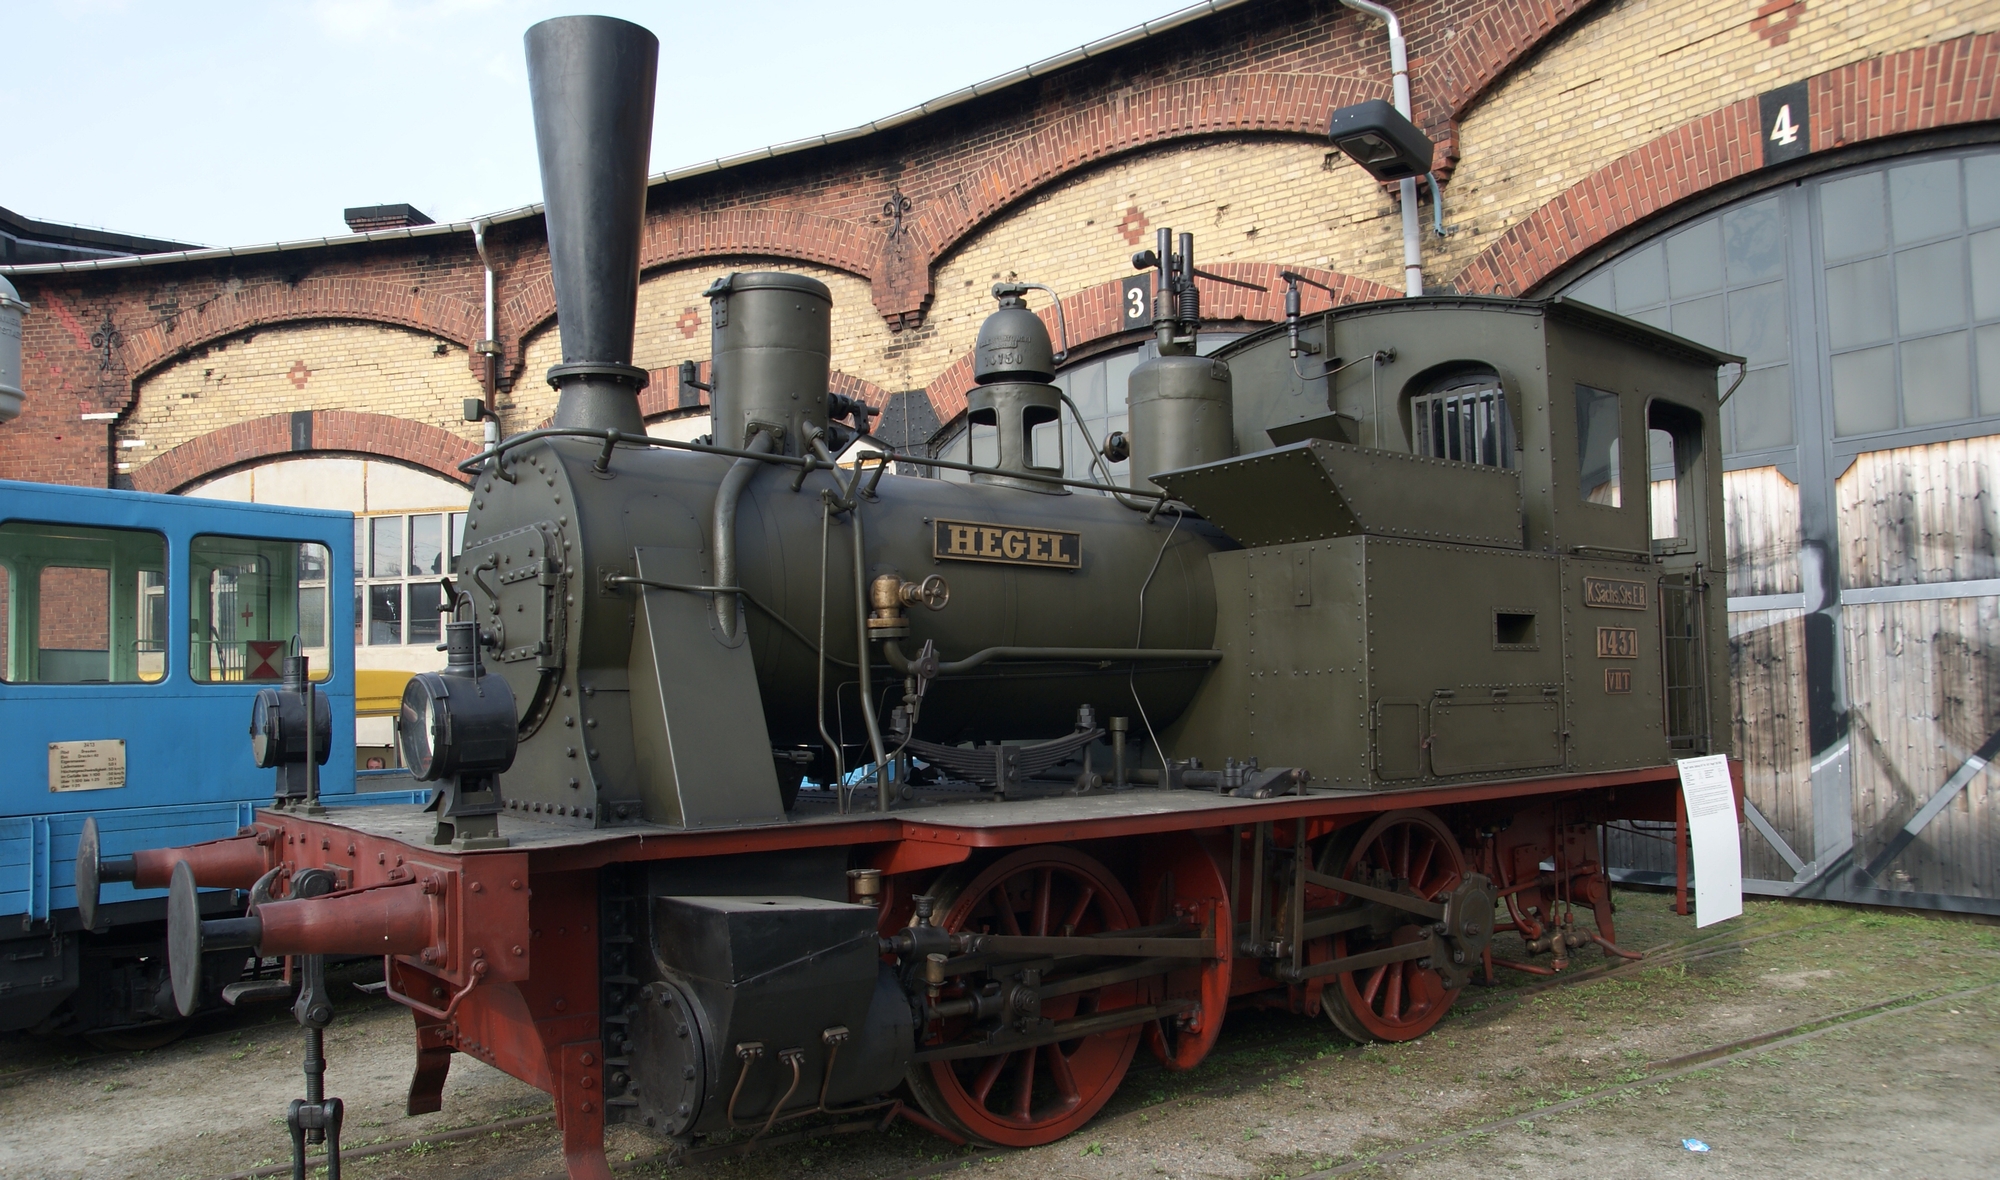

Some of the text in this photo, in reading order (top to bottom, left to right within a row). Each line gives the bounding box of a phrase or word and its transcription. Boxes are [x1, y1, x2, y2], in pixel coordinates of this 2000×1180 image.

[1770, 104, 1799, 146] 4
[1128, 287, 1144, 318] 3
[297, 422, 305, 450] 1
[948, 525, 1070, 562] HEGEL
[1601, 630, 1636, 655] 1431
